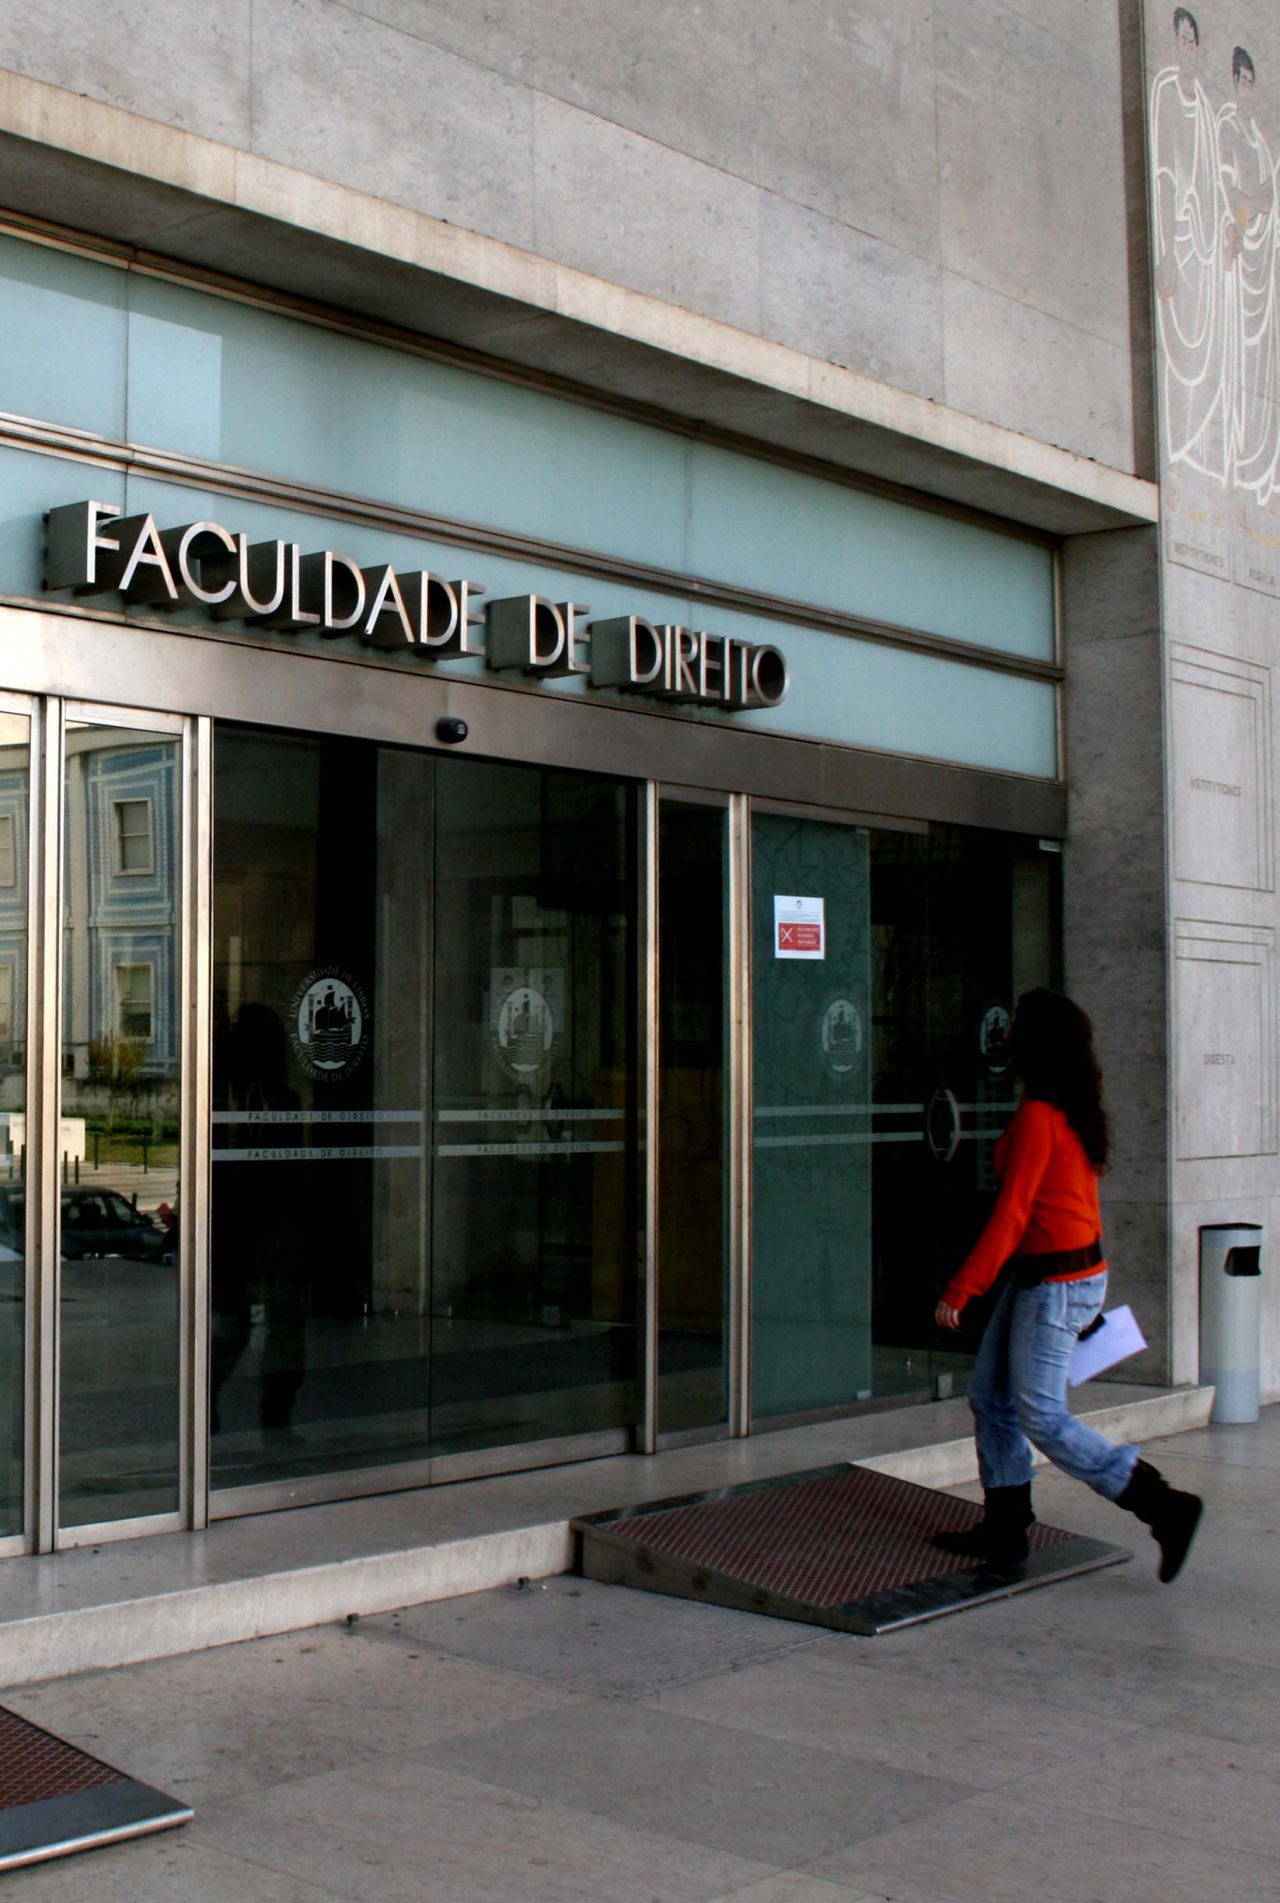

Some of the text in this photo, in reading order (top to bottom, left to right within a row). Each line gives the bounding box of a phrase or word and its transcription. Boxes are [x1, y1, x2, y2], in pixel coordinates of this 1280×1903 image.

[85, 500, 790, 708] FACULDADE DE DIREITO
